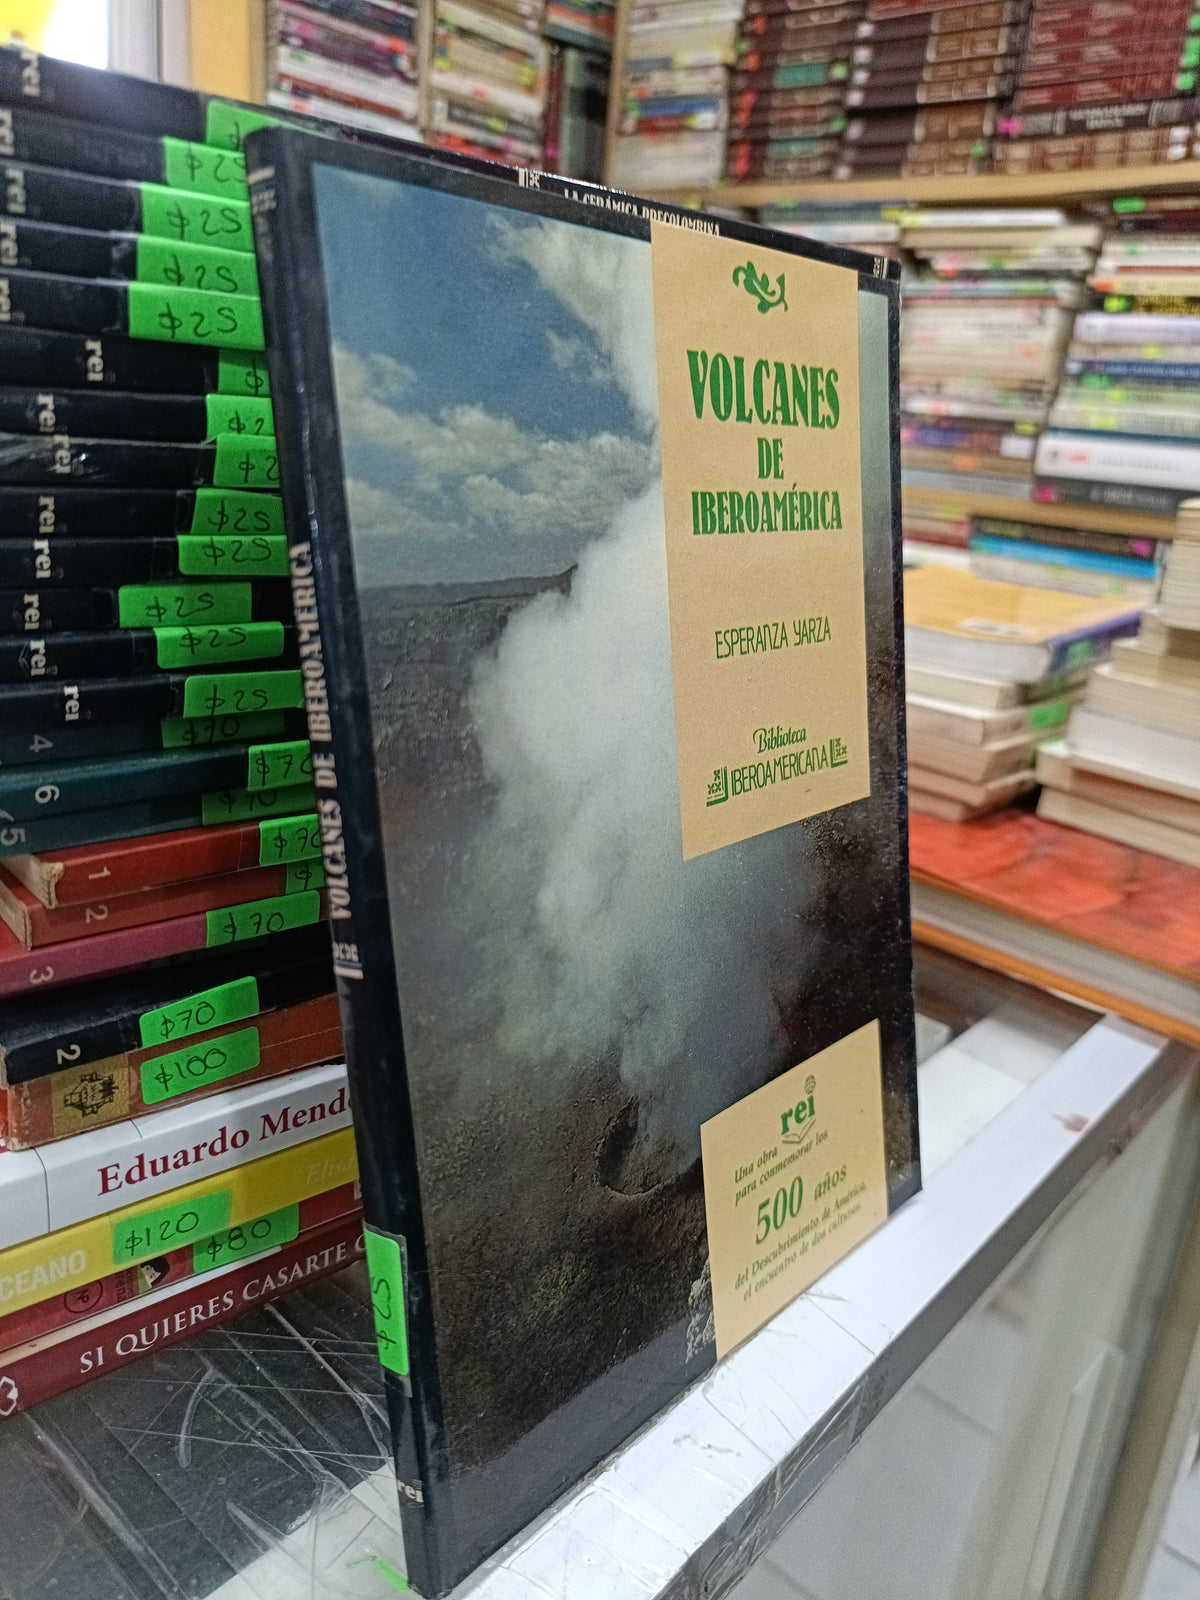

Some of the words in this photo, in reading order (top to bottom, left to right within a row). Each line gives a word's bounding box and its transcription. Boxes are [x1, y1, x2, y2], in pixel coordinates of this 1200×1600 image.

[85, 340, 104, 382] rei
[686, 348, 841, 430] VOLCANES
[37, 393, 57, 433] rei
[228, 411, 265, 435] $2
[53, 434, 72, 474] rei
[239, 454, 281, 483] $2
[757, 437, 784, 480] DE
[38, 496, 56, 533] rei
[691, 483, 843, 536] IBEROAMÉRICA
[33, 539, 52, 579] rei
[23, 593, 40, 630] rei
[29, 639, 46, 676] rei
[714, 621, 789, 660] ESPERANZA
[793, 615, 832, 647] YARZA
[63, 685, 80, 721] rei
[29, 734, 53, 752] 4
[752, 725, 808, 754] Biblioteca
[312, 752, 338, 789] DE
[730, 744, 829, 797] IBEROAMERICANA
[35, 785, 60, 804] 6
[0, 828, 26, 847] 5
[88, 866, 111, 880] 1
[85, 904, 109, 924] 2
[29, 966, 54, 985] 3
[160, 1001, 216, 1039] $70
[56, 1043, 82, 1066] 2
[154, 1047, 228, 1092] $100
[780, 1074, 817, 1136] rei
[97, 1126, 250, 1197] Eduardo
[734, 1180, 757, 1207] para
[760, 1139, 814, 1185] conmemorar
[816, 1130, 829, 1146] los
[735, 1163, 754, 1184] Una
[757, 1146, 778, 1169] obra
[755, 1174, 803, 1245] 500
[814, 1164, 848, 1202] años
[124, 1211, 200, 1257] $120
[206, 1218, 273, 1262] $80
[735, 1267, 750, 1290] del
[752, 1217, 820, 1277] Descubrimiento
[0, 1250, 87, 1303] CEANO
[79, 1346, 104, 1375] SI
[115, 1291, 235, 1356] QUIERES
[242, 1240, 348, 1302] CASARTE
